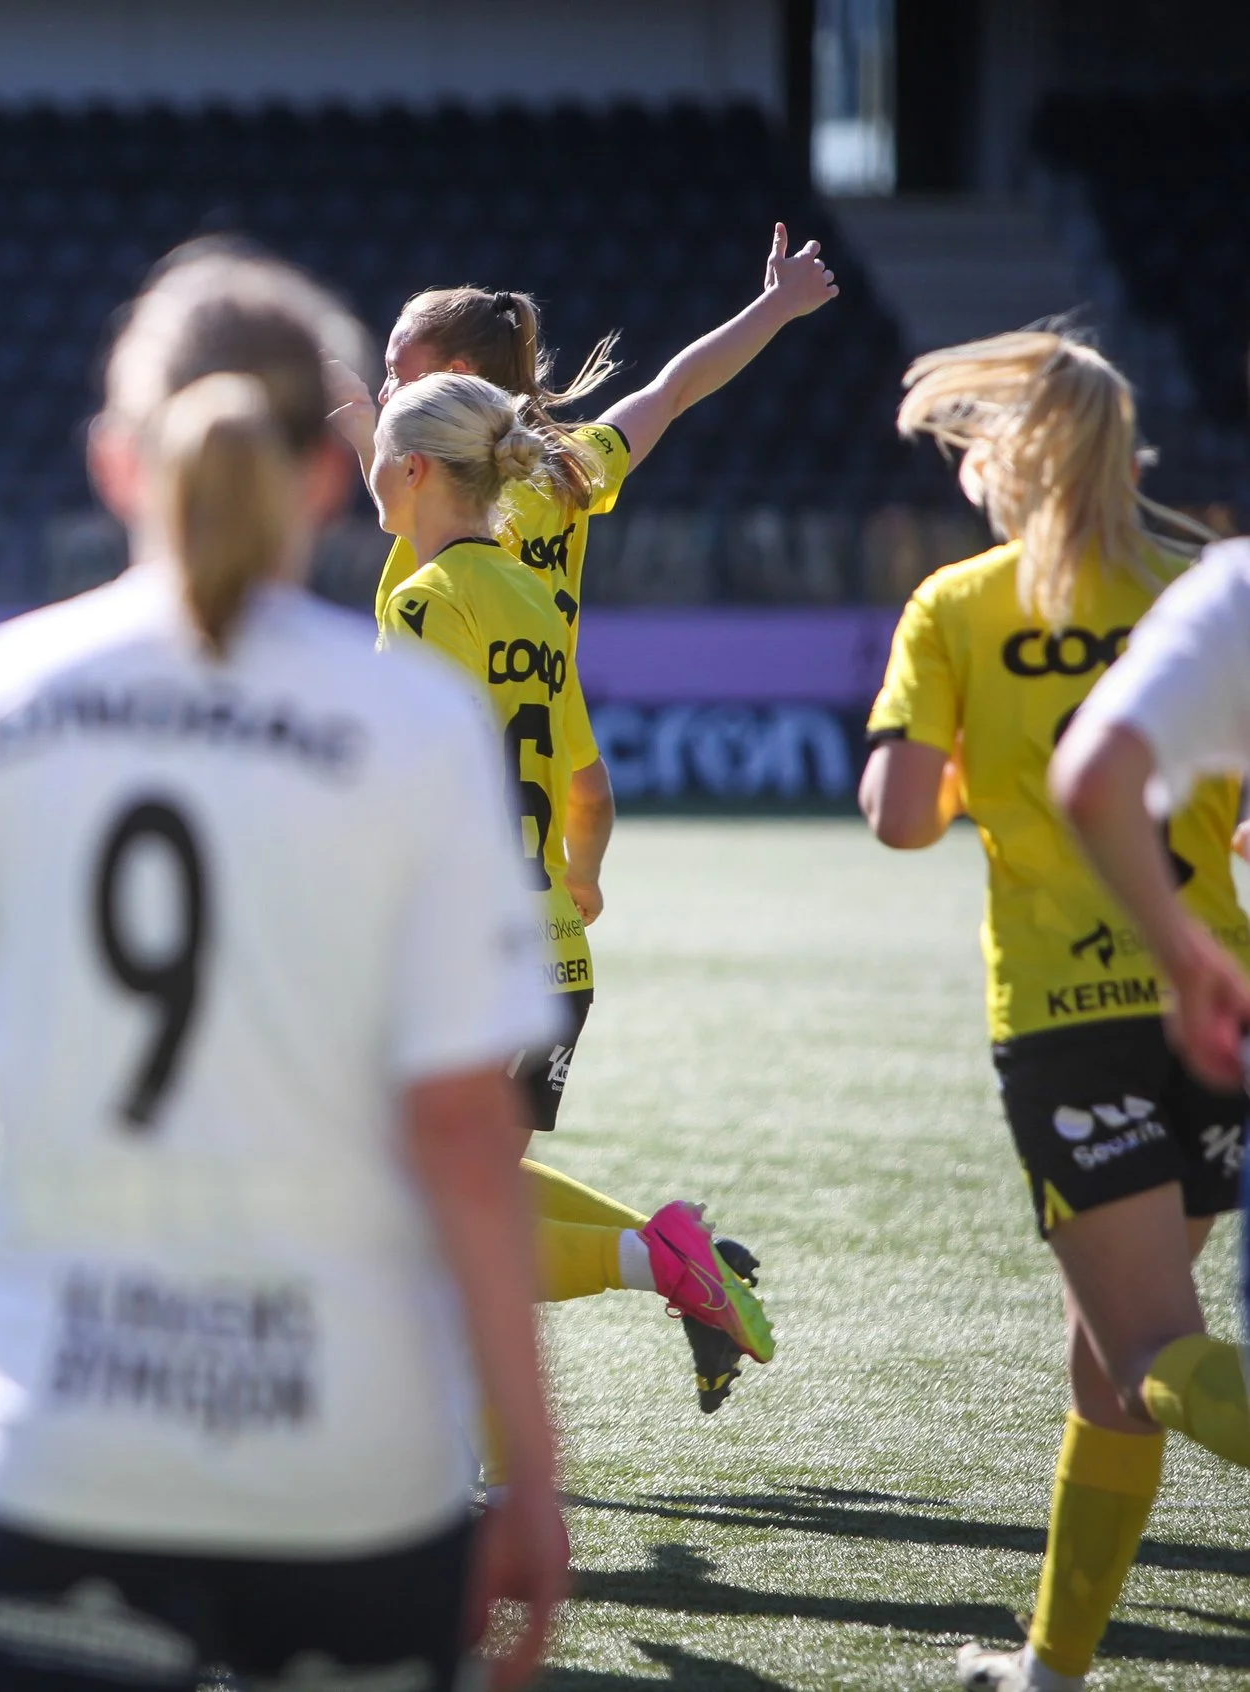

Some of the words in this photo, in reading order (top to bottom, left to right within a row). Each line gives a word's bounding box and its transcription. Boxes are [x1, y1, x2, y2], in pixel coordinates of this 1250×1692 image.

[488, 637, 566, 701] coop
[1002, 625, 1134, 677] coo
[596, 703, 852, 798] cron
[92, 792, 210, 1132] 9
[543, 957, 588, 985] NGER
